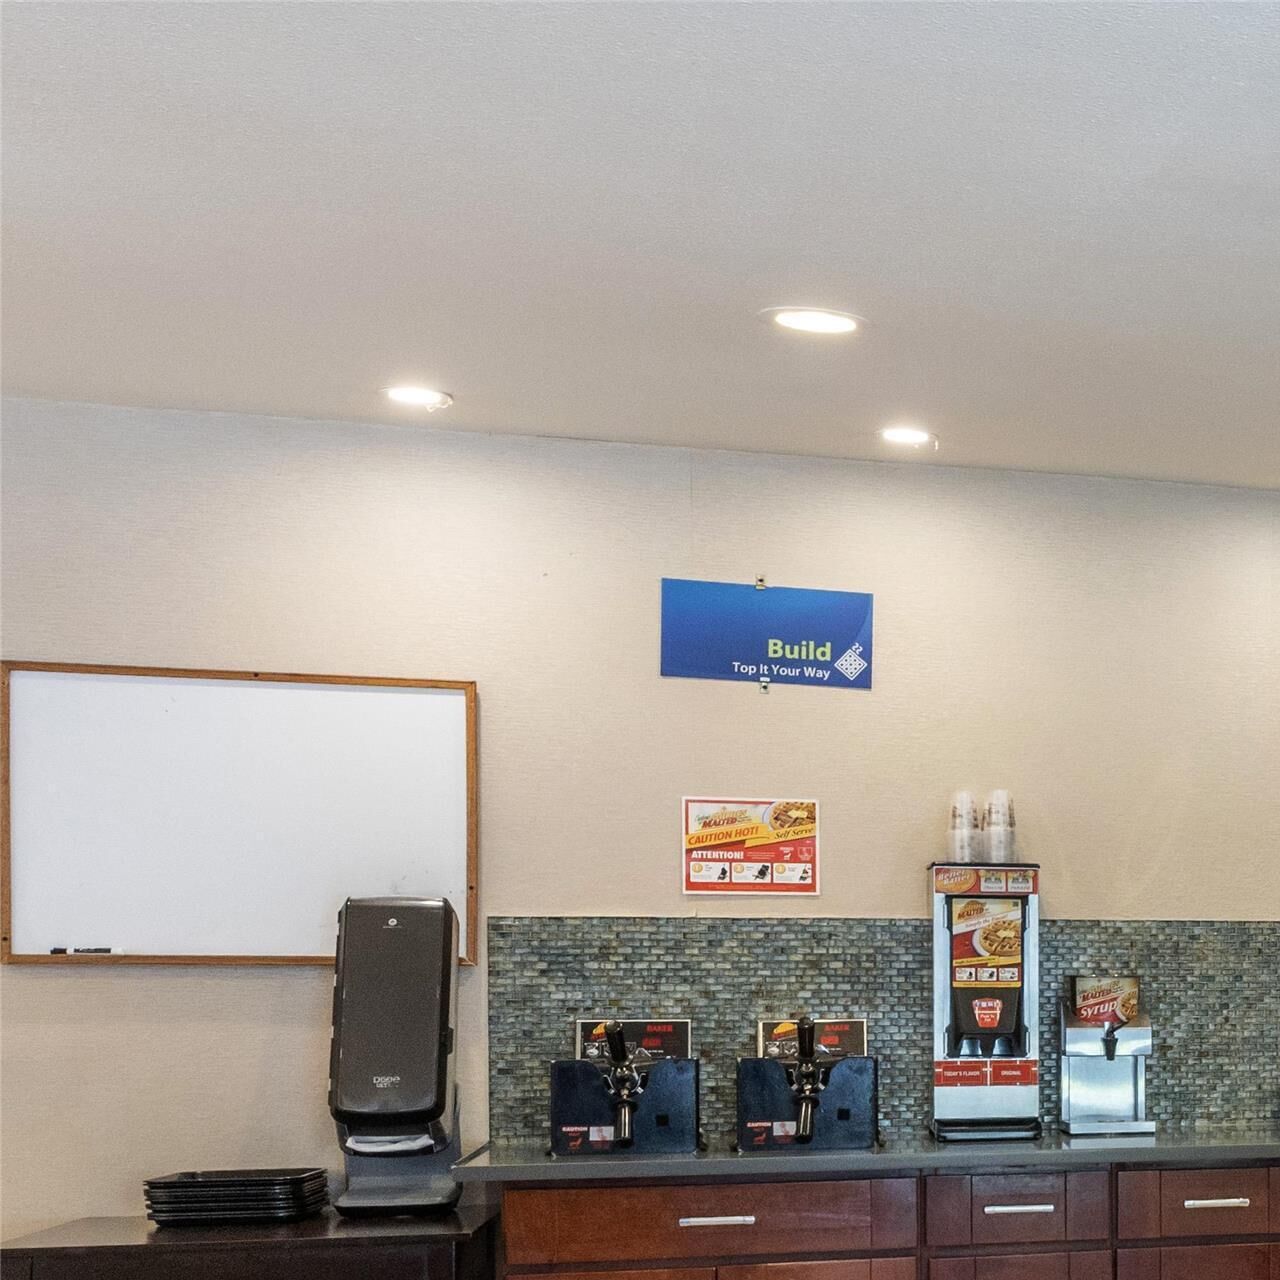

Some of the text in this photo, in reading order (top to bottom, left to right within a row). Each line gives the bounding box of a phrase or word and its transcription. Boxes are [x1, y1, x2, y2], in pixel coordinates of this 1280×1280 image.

[767, 639, 832, 661] Build
[732, 662, 831, 680] Top It Your Way
[688, 826, 759, 845] CAUTION HOT!
[774, 826, 814, 840] Self Serve
[691, 850, 744, 860] ATTENTION!
[1080, 1001, 1117, 1018] Syrup
